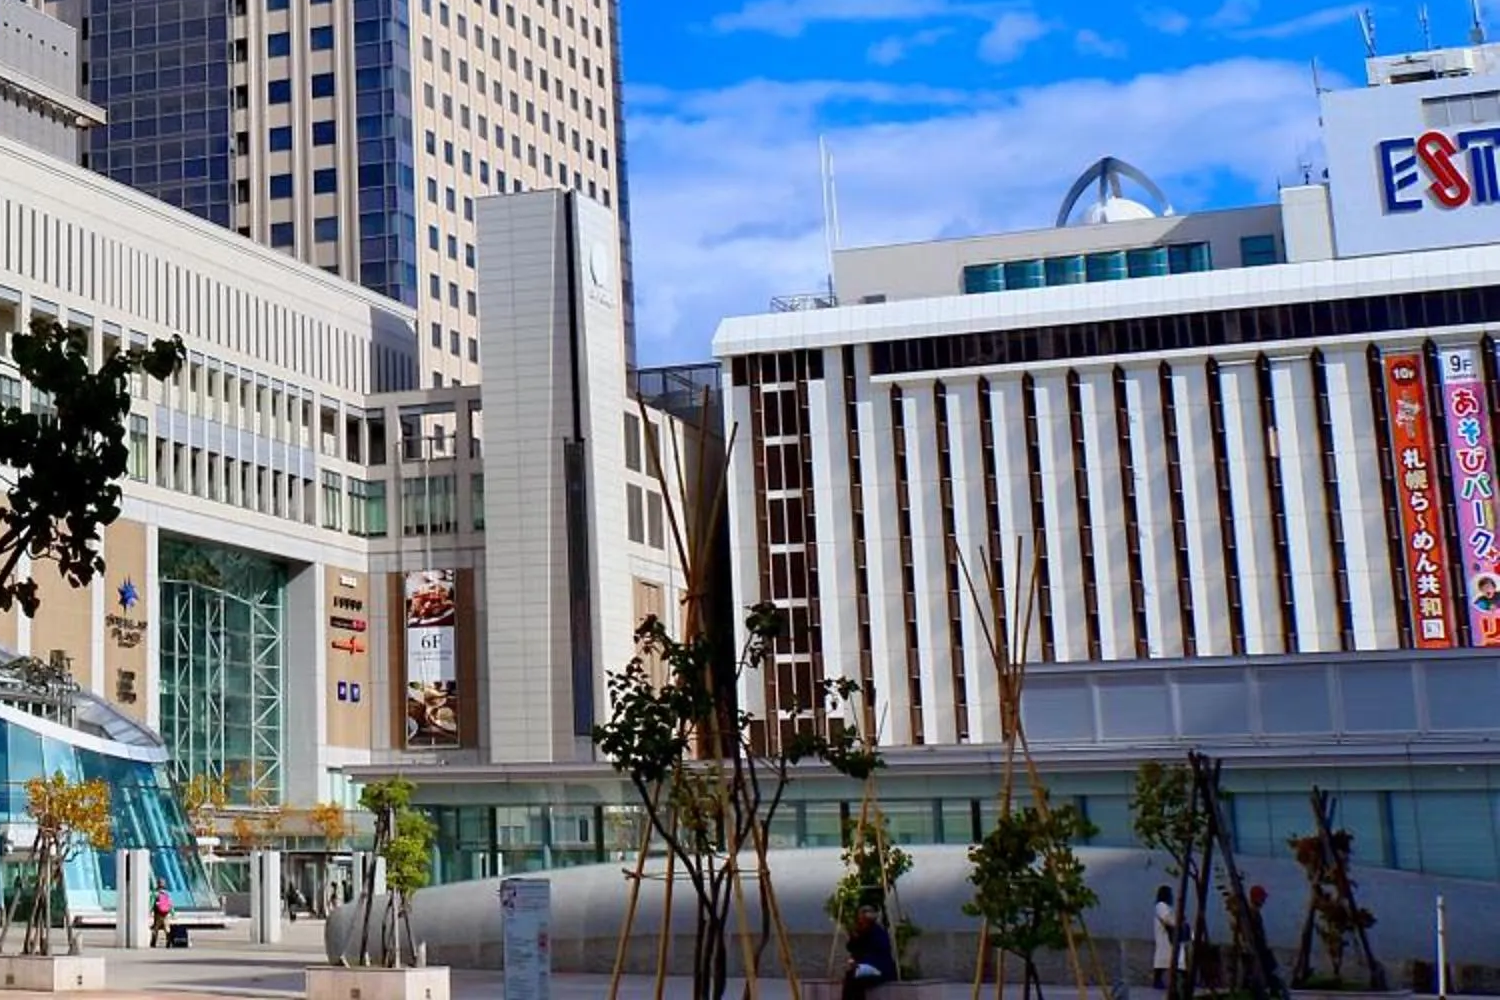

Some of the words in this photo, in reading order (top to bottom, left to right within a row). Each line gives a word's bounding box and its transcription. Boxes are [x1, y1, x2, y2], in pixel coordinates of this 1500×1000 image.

[1449, 355, 1472, 373] 9F
[1452, 388, 1495, 558] あそびパーク
[420, 633, 444, 649] 6F
